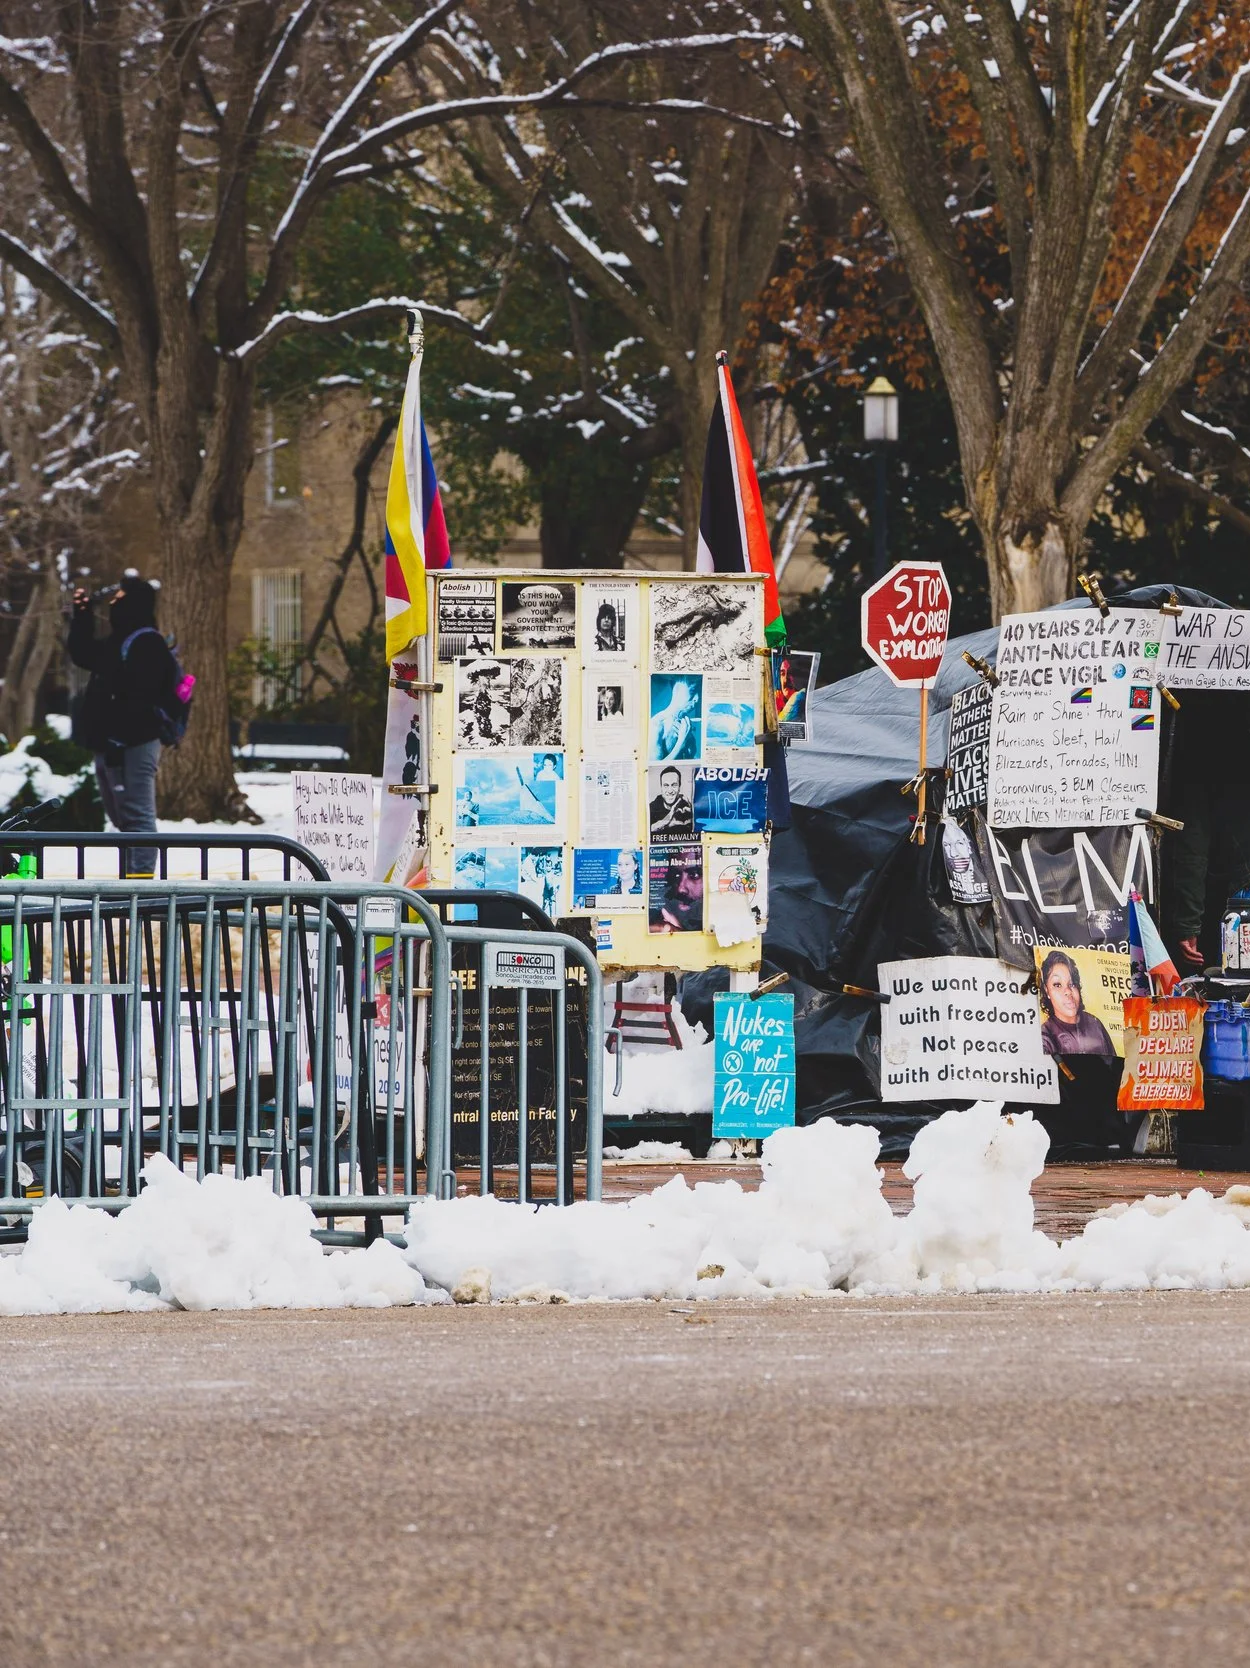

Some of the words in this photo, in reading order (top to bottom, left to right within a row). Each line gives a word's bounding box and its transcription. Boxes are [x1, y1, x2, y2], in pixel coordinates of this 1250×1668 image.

[894, 574, 943, 609] STOP
[887, 609, 947, 637] WORKER
[1004, 623, 1024, 641] 40
[1028, 618, 1080, 640] YEARS
[1175, 612, 1217, 638] WAR
[1223, 614, 1245, 639] IS
[999, 640, 1140, 665] ANTI-NUCLEAR
[1166, 643, 1201, 669] THE
[999, 668, 1053, 687] PEACE
[1168, 673, 1194, 686] Marvin
[953, 681, 993, 714] BLACK
[1000, 689, 1031, 700] Surviving
[952, 701, 992, 732] FATHERS
[997, 702, 1026, 724] Rain
[1033, 711, 1044, 721] or
[1097, 703, 1123, 720] thru
[1052, 728, 1088, 748] Sleet,
[995, 754, 1053, 772] Blizzards,
[1056, 752, 1110, 769] Tornados,
[695, 768, 769, 782] ABOLISH
[995, 777, 1057, 795] Coronavirus,
[1060, 777, 1068, 792] 3
[1073, 776, 1094, 791] BLM
[295, 805, 309, 826] This
[310, 812, 317, 825] is
[346, 806, 365, 826] House
[708, 791, 752, 820] ICE
[1100, 806, 1130, 822] FENCE
[652, 834, 667, 842] FREE
[668, 833, 699, 841] NAVALNY
[500, 966, 554, 975] BARRICADE
[511, 955, 542, 965] SONCO
[893, 978, 924, 997] We
[931, 976, 978, 992] want
[495, 1006, 517, 1015] Capitol
[899, 1005, 940, 1026] with
[947, 1003, 1037, 1025] freedom?
[1149, 1010, 1188, 1031] BIDEN
[722, 1002, 786, 1047] Nukes
[534, 1038, 543, 1046] SE
[741, 1037, 763, 1056] are
[922, 1035, 956, 1053] Not
[963, 1039, 1019, 1056] peace
[1138, 1037, 1194, 1055] DECLARE
[753, 1045, 788, 1073] not
[1136, 1060, 1193, 1079] CLIMATE
[888, 1066, 929, 1085] with
[937, 1063, 1053, 1090] dictatorship!
[1132, 1083, 1193, 1101] EMERGENCY
